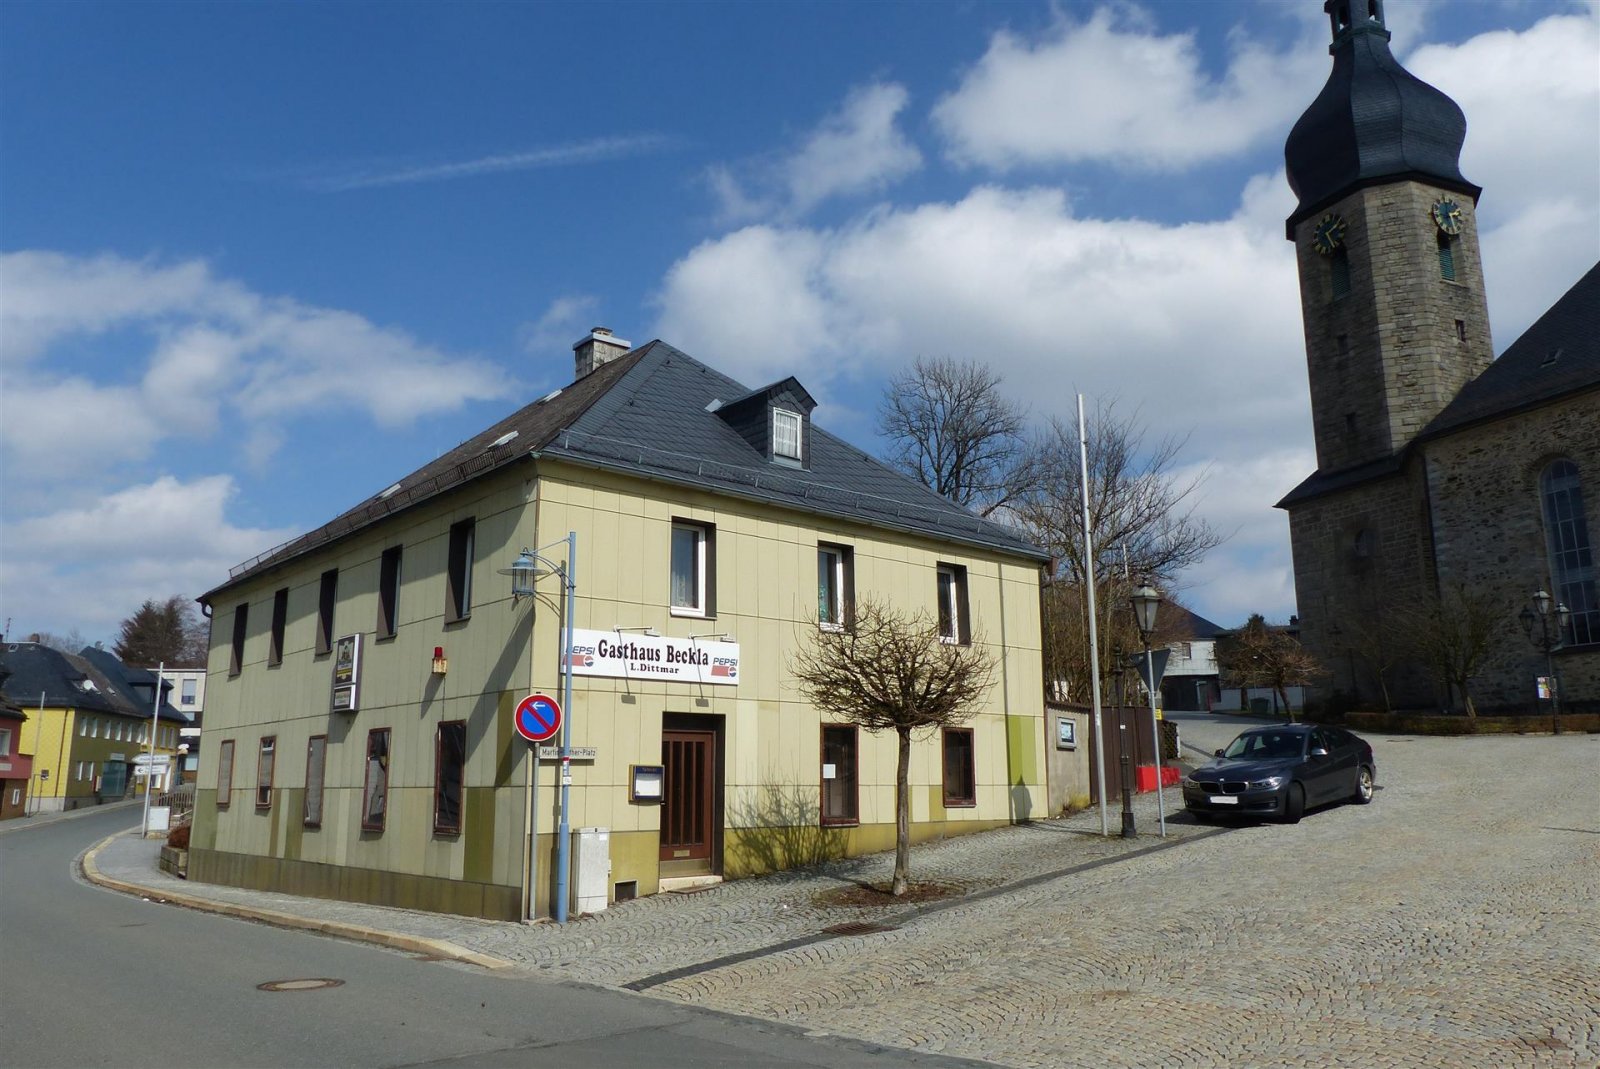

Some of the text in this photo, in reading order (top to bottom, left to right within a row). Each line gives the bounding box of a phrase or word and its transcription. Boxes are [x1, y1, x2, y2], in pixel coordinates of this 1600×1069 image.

[566, 645, 596, 656] EPSI
[598, 639, 709, 666] Gasthaus Beckla
[713, 657, 738, 667] PEPSI
